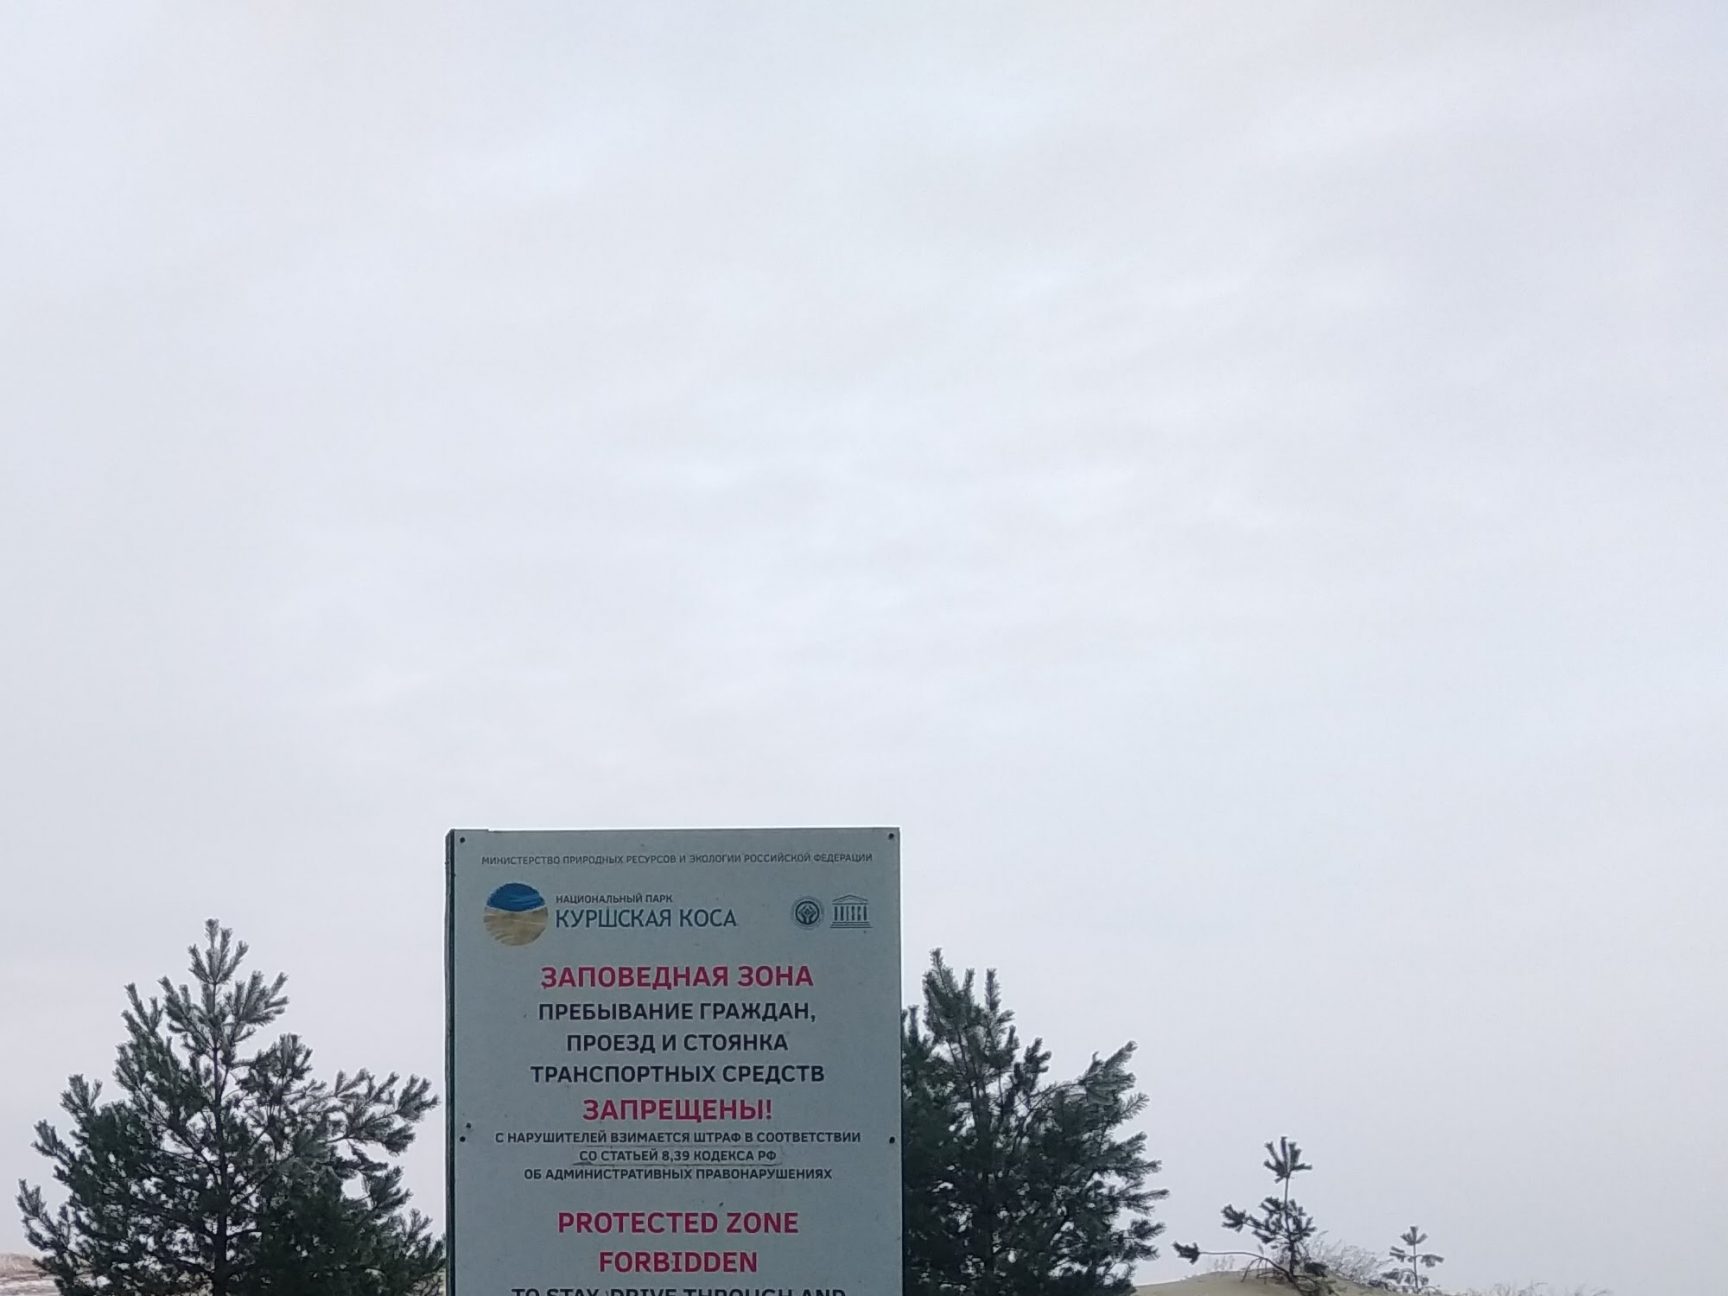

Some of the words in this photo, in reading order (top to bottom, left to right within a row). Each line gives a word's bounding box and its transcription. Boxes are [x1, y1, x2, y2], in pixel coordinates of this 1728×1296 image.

[482, 856, 560, 864] МИНИСТЕРСТВО
[563, 856, 623, 864] ПРИРОДНЫХ
[626, 855, 676, 864] РЕСУРСОВ
[678, 854, 687, 864] И
[689, 853, 741, 864] ЭКОЛОГИИ
[744, 853, 811, 863] РОССИЙСКОЙ
[813, 853, 873, 863] ФЕДЕРАЦИИ
[556, 893, 642, 904] НАЦИОНАЛЬНЫЙ
[645, 895, 673, 903] ПАРК
[556, 908, 671, 928] КУРШСКАЯ
[680, 909, 737, 927] КОСА
[541, 967, 728, 990] ЗАПОВЕДНАЯ
[738, 966, 813, 986] ЗОНА
[540, 1003, 693, 1020] ПРЕБЫВАНИЕ
[701, 1003, 815, 1022] ГРАЖДАН,
[568, 1035, 655, 1053] ПРОЕЗД
[663, 1034, 676, 1051] И
[684, 1034, 788, 1051] СТОЯНКА
[531, 1066, 715, 1082] ТРАНСПОРТНЫХ
[723, 1065, 824, 1084] СРЕДСТВ
[583, 1099, 771, 1123] ЗАПРЕЩЕНЫ!
[496, 1133, 504, 1142] С
[507, 1130, 607, 1143] НАРУШИТЕЛЕЙ
[611, 1132, 690, 1143] ВЗИМАЕТСЯ
[694, 1132, 741, 1143] ШТРАФ
[745, 1132, 753, 1142] В
[757, 1132, 861, 1143] СООТВЕТСТВИИ
[579, 1151, 597, 1161] СО
[601, 1148, 658, 1161] СТАТЬЕЙ
[694, 1151, 754, 1162] КОДЕКСА
[758, 1151, 776, 1161] РФ
[525, 1169, 541, 1179] ОБ
[545, 1168, 692, 1181] АДМИНИСТРАТИВНЫХ
[696, 1168, 833, 1180] ПРАВОНАРУШЕНИЯХ
[559, 1213, 717, 1233] PROTECTED
[727, 1212, 798, 1233] ZONE
[600, 1252, 756, 1272] FORBIDDEN
